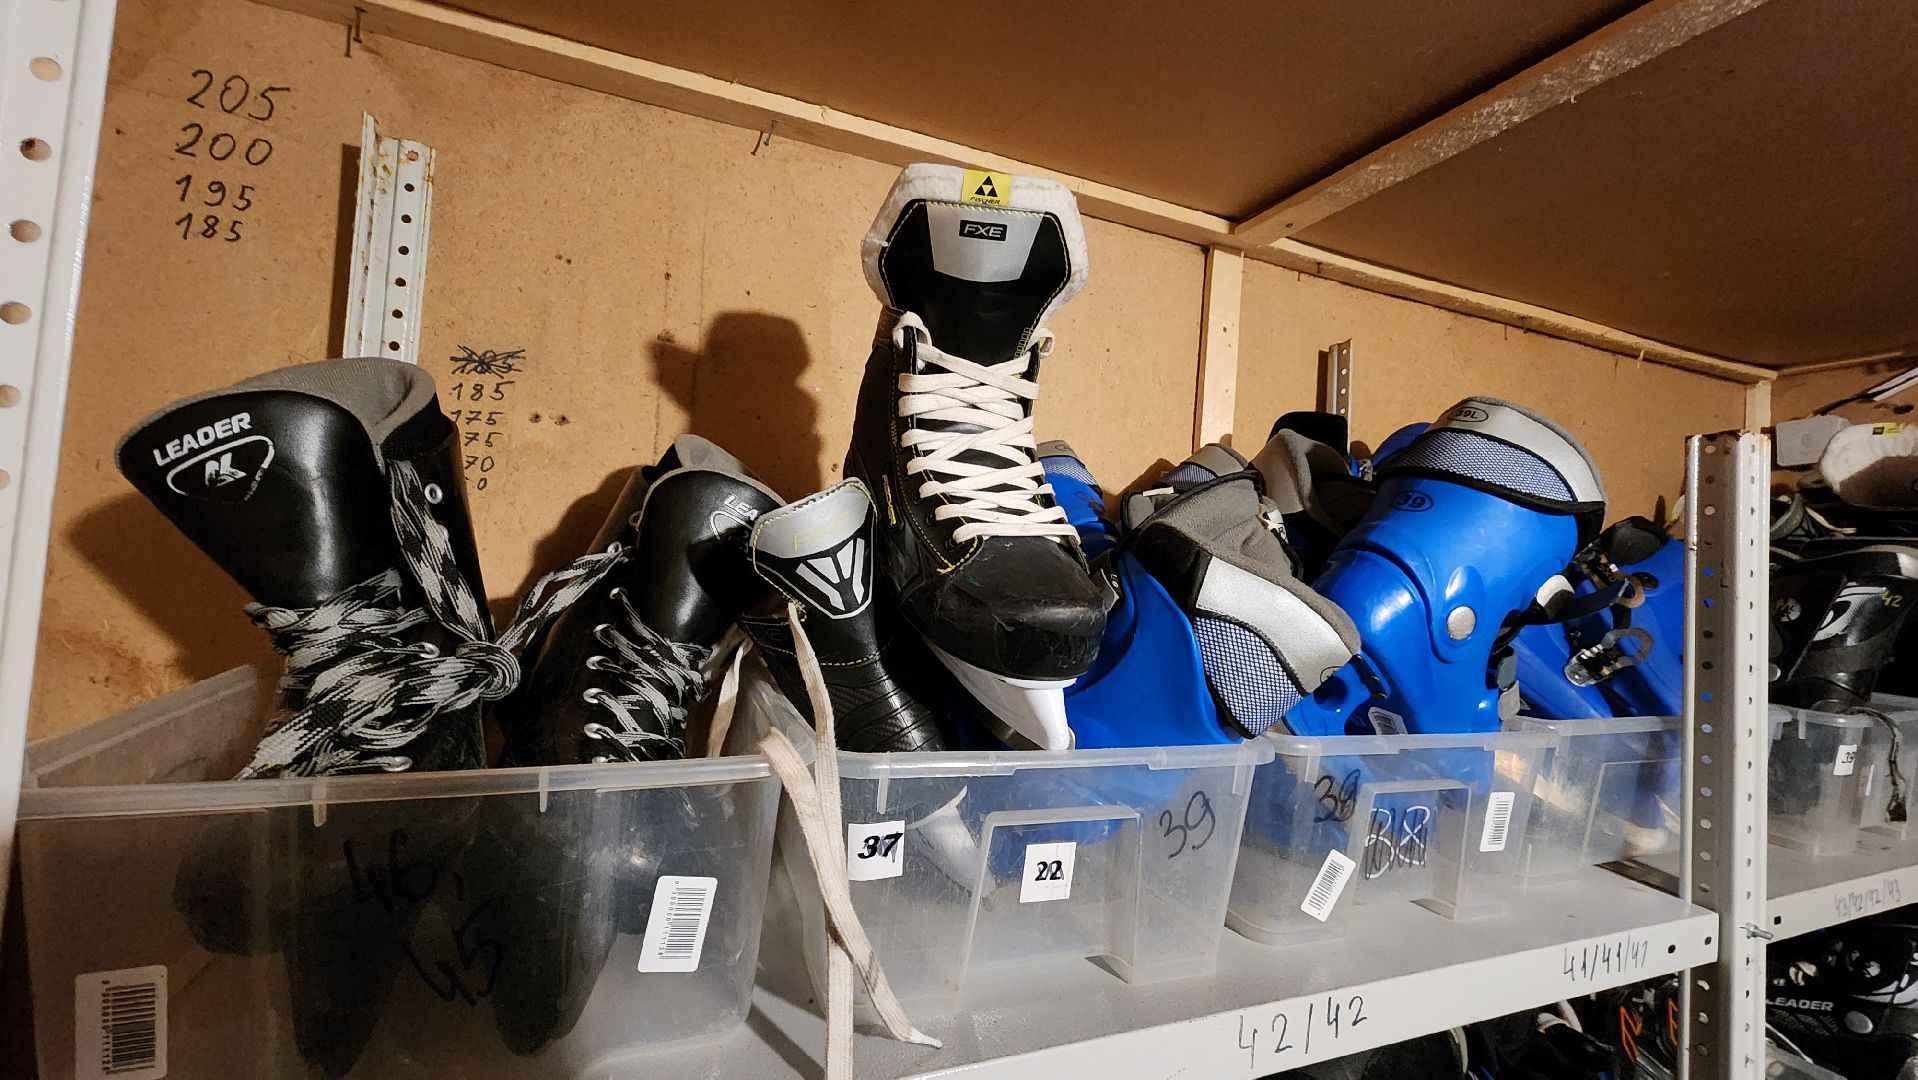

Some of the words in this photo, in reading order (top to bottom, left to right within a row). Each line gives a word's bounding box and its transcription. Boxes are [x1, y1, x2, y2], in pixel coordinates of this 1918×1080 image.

[187, 70, 291, 121] 205
[175, 123, 273, 166] 200
[175, 174, 256, 211] 195
[175, 212, 244, 242] 185
[963, 223, 1004, 238] FXE
[451, 381, 515, 401] 185
[450, 409, 504, 426] 175
[153, 412, 253, 467] LEADER
[1881, 590, 1902, 608] 42
[1159, 790, 1216, 860] 39
[857, 831, 904, 864] 37
[1034, 859, 1065, 882] 22
